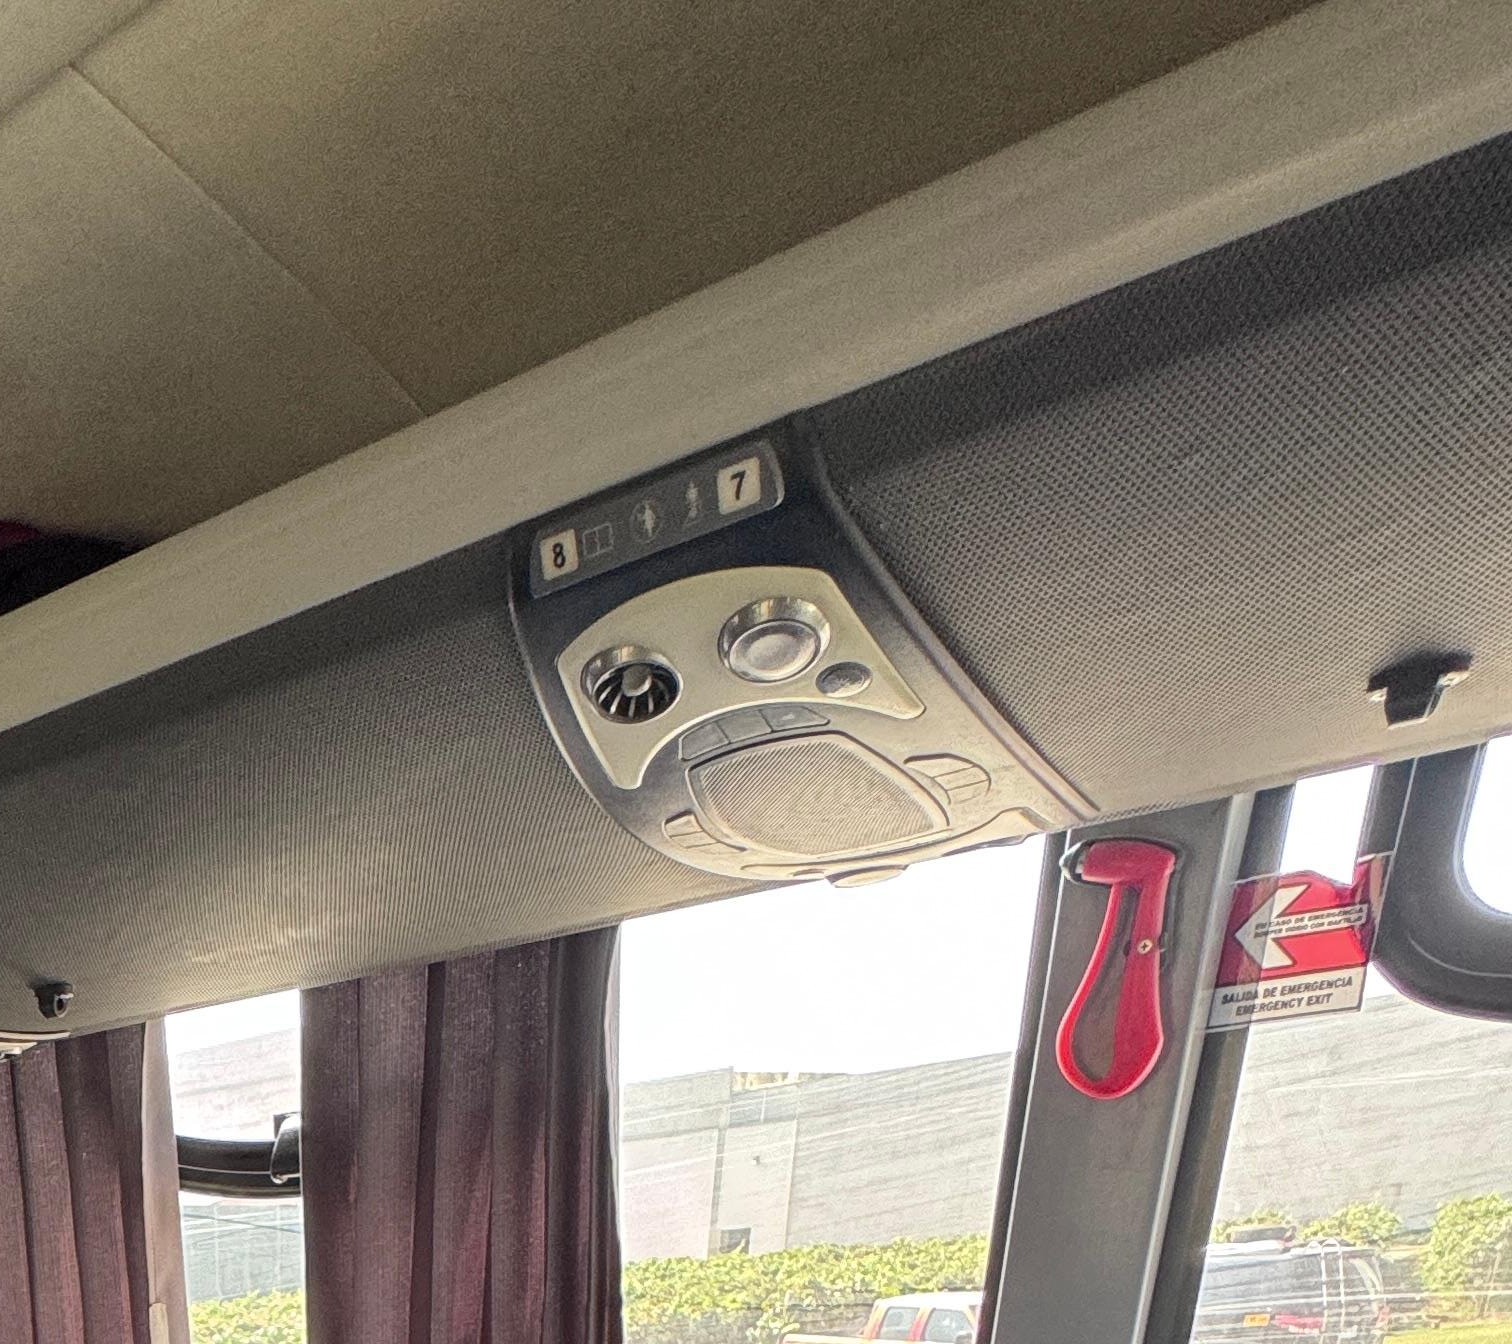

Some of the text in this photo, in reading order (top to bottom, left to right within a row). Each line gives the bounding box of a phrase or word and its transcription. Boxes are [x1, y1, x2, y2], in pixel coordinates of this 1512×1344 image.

[551, 470, 747, 569] 8 7
[1268, 917, 1292, 929] CASO
[1294, 916, 1307, 924] DE
[1307, 907, 1364, 922] EMERGENCIA
[1221, 976, 1353, 1005] SALIDA DE EMERGENCIA
[1235, 993, 1334, 1016] EMERGENCY EXIT
